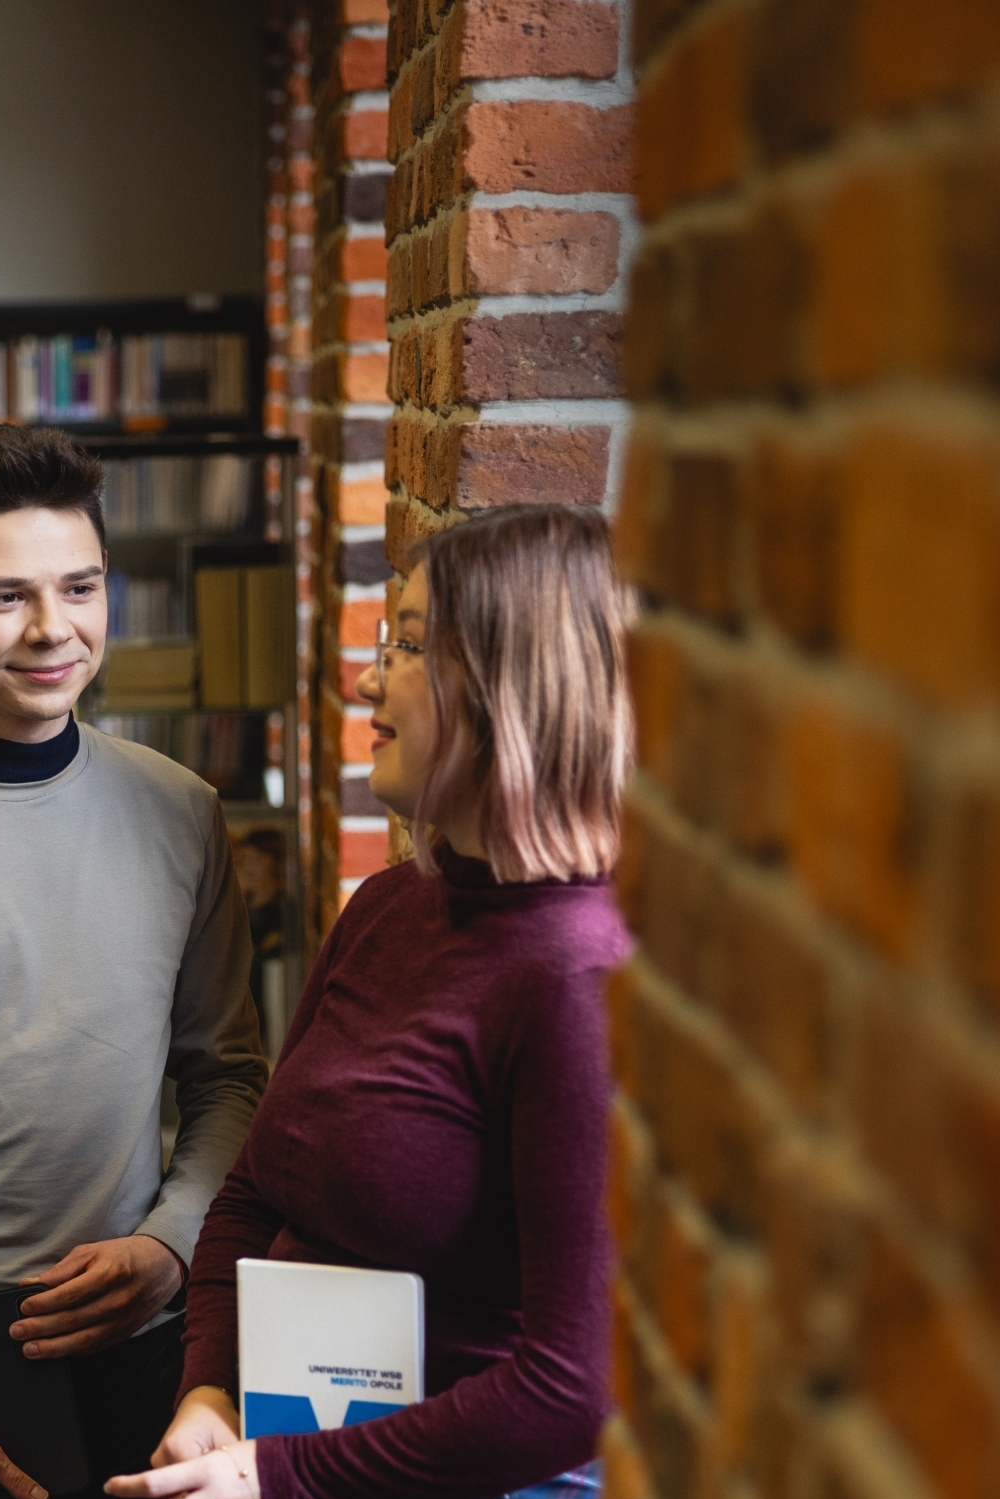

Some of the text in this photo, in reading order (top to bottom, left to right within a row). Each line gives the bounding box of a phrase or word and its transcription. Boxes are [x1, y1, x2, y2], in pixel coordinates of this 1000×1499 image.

[308, 1365, 403, 1380] UNIWERSYTET WSB
[330, 1377, 403, 1390] MERITO OPOLE
